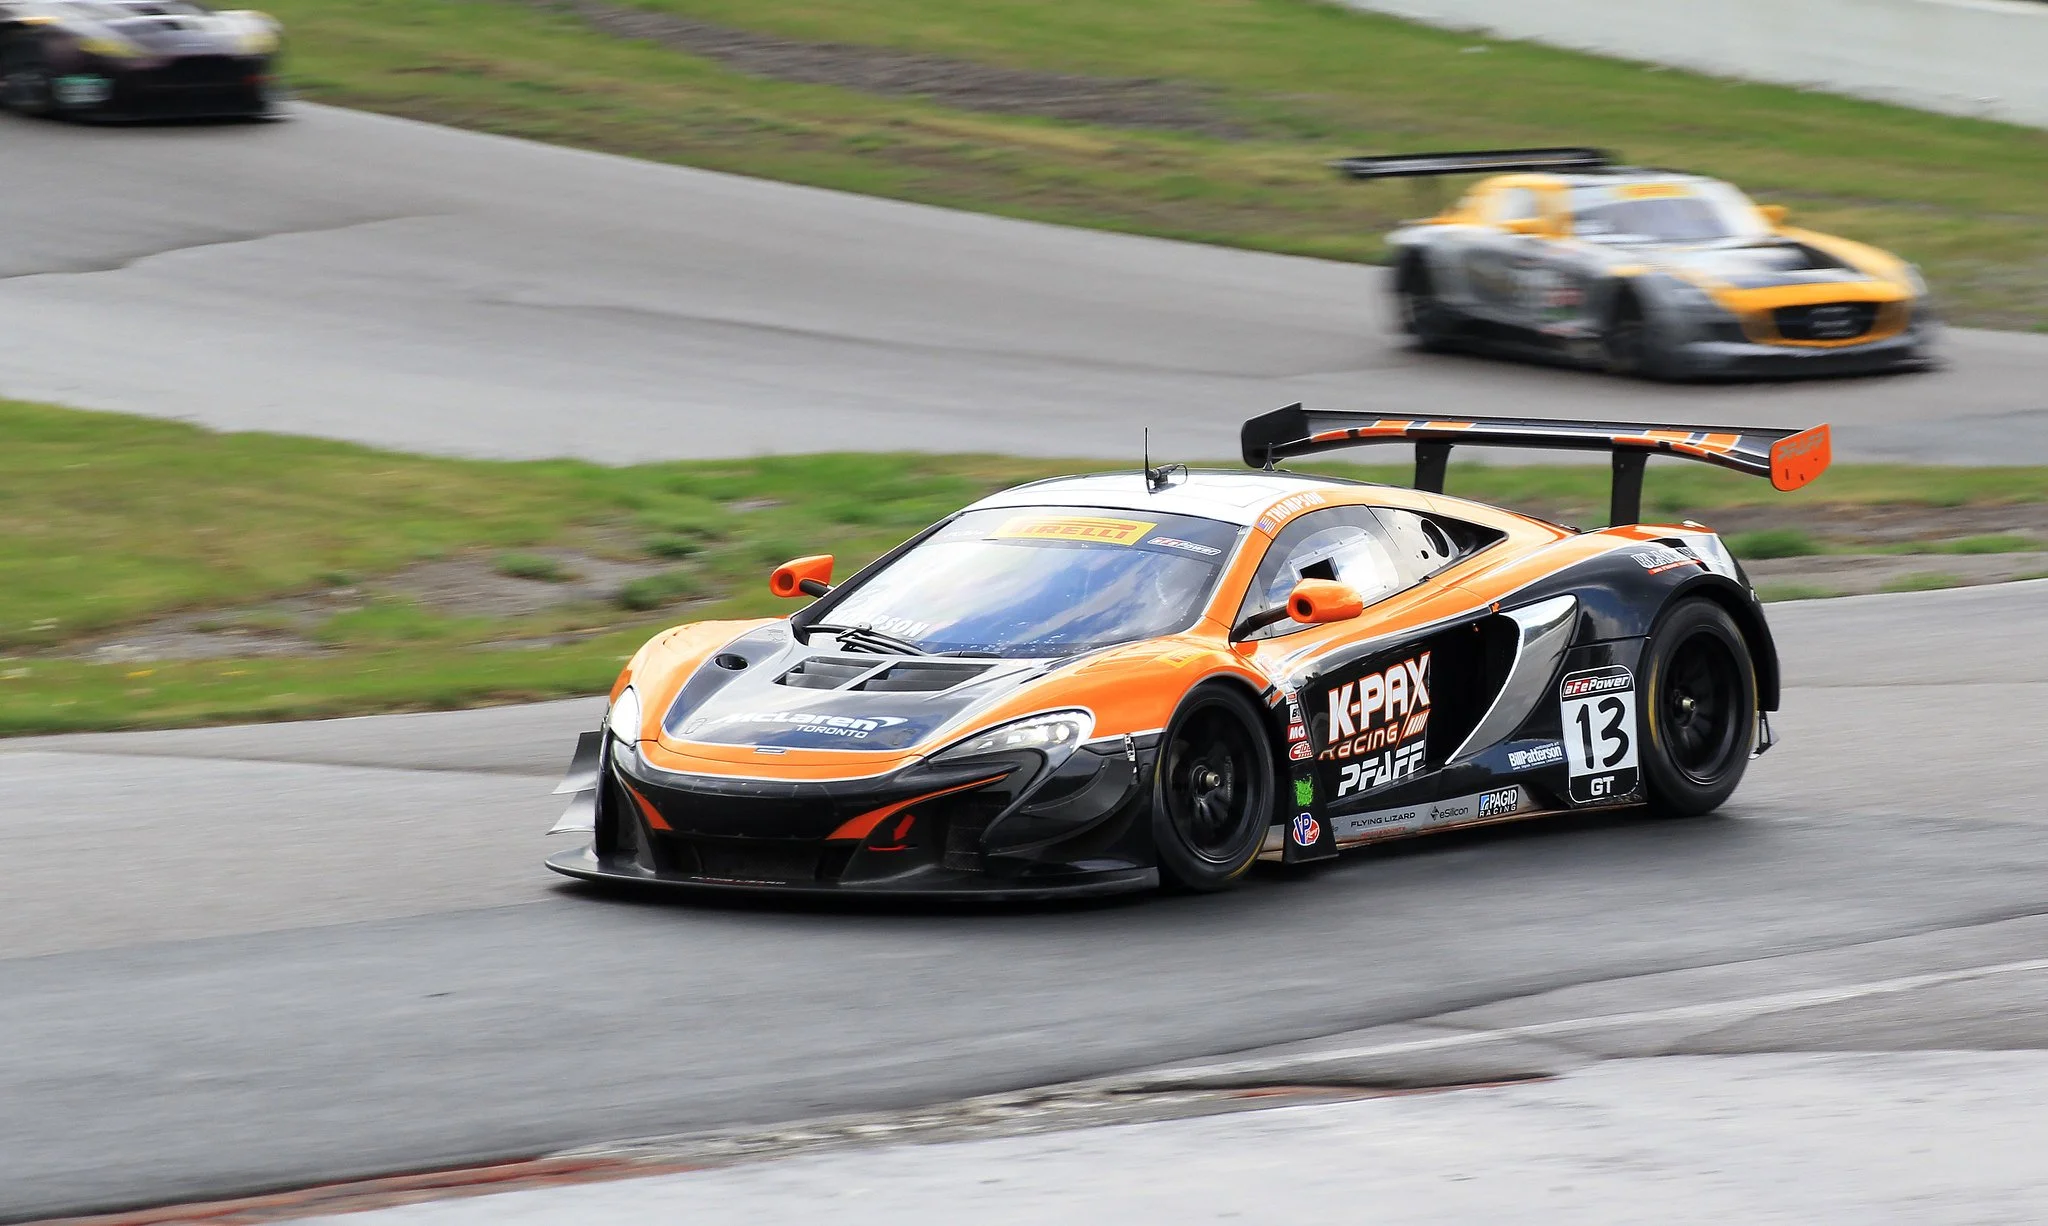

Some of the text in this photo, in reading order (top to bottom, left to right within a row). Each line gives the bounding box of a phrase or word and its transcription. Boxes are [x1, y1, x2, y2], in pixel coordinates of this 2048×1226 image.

[1265, 491, 1326, 522] THOMPSON
[1328, 651, 1431, 744] K-PAX
[796, 725, 868, 739] TORONTO
[1576, 697, 1629, 769] 13
[1337, 740, 1425, 797] PFAFF
[1591, 776, 1614, 796] GT
[1489, 789, 1517, 810] PAGID
[1350, 811, 1415, 828] FLYING LIZARD
[1439, 806, 1468, 819] eSilicon
[1479, 803, 1517, 817] RACING
